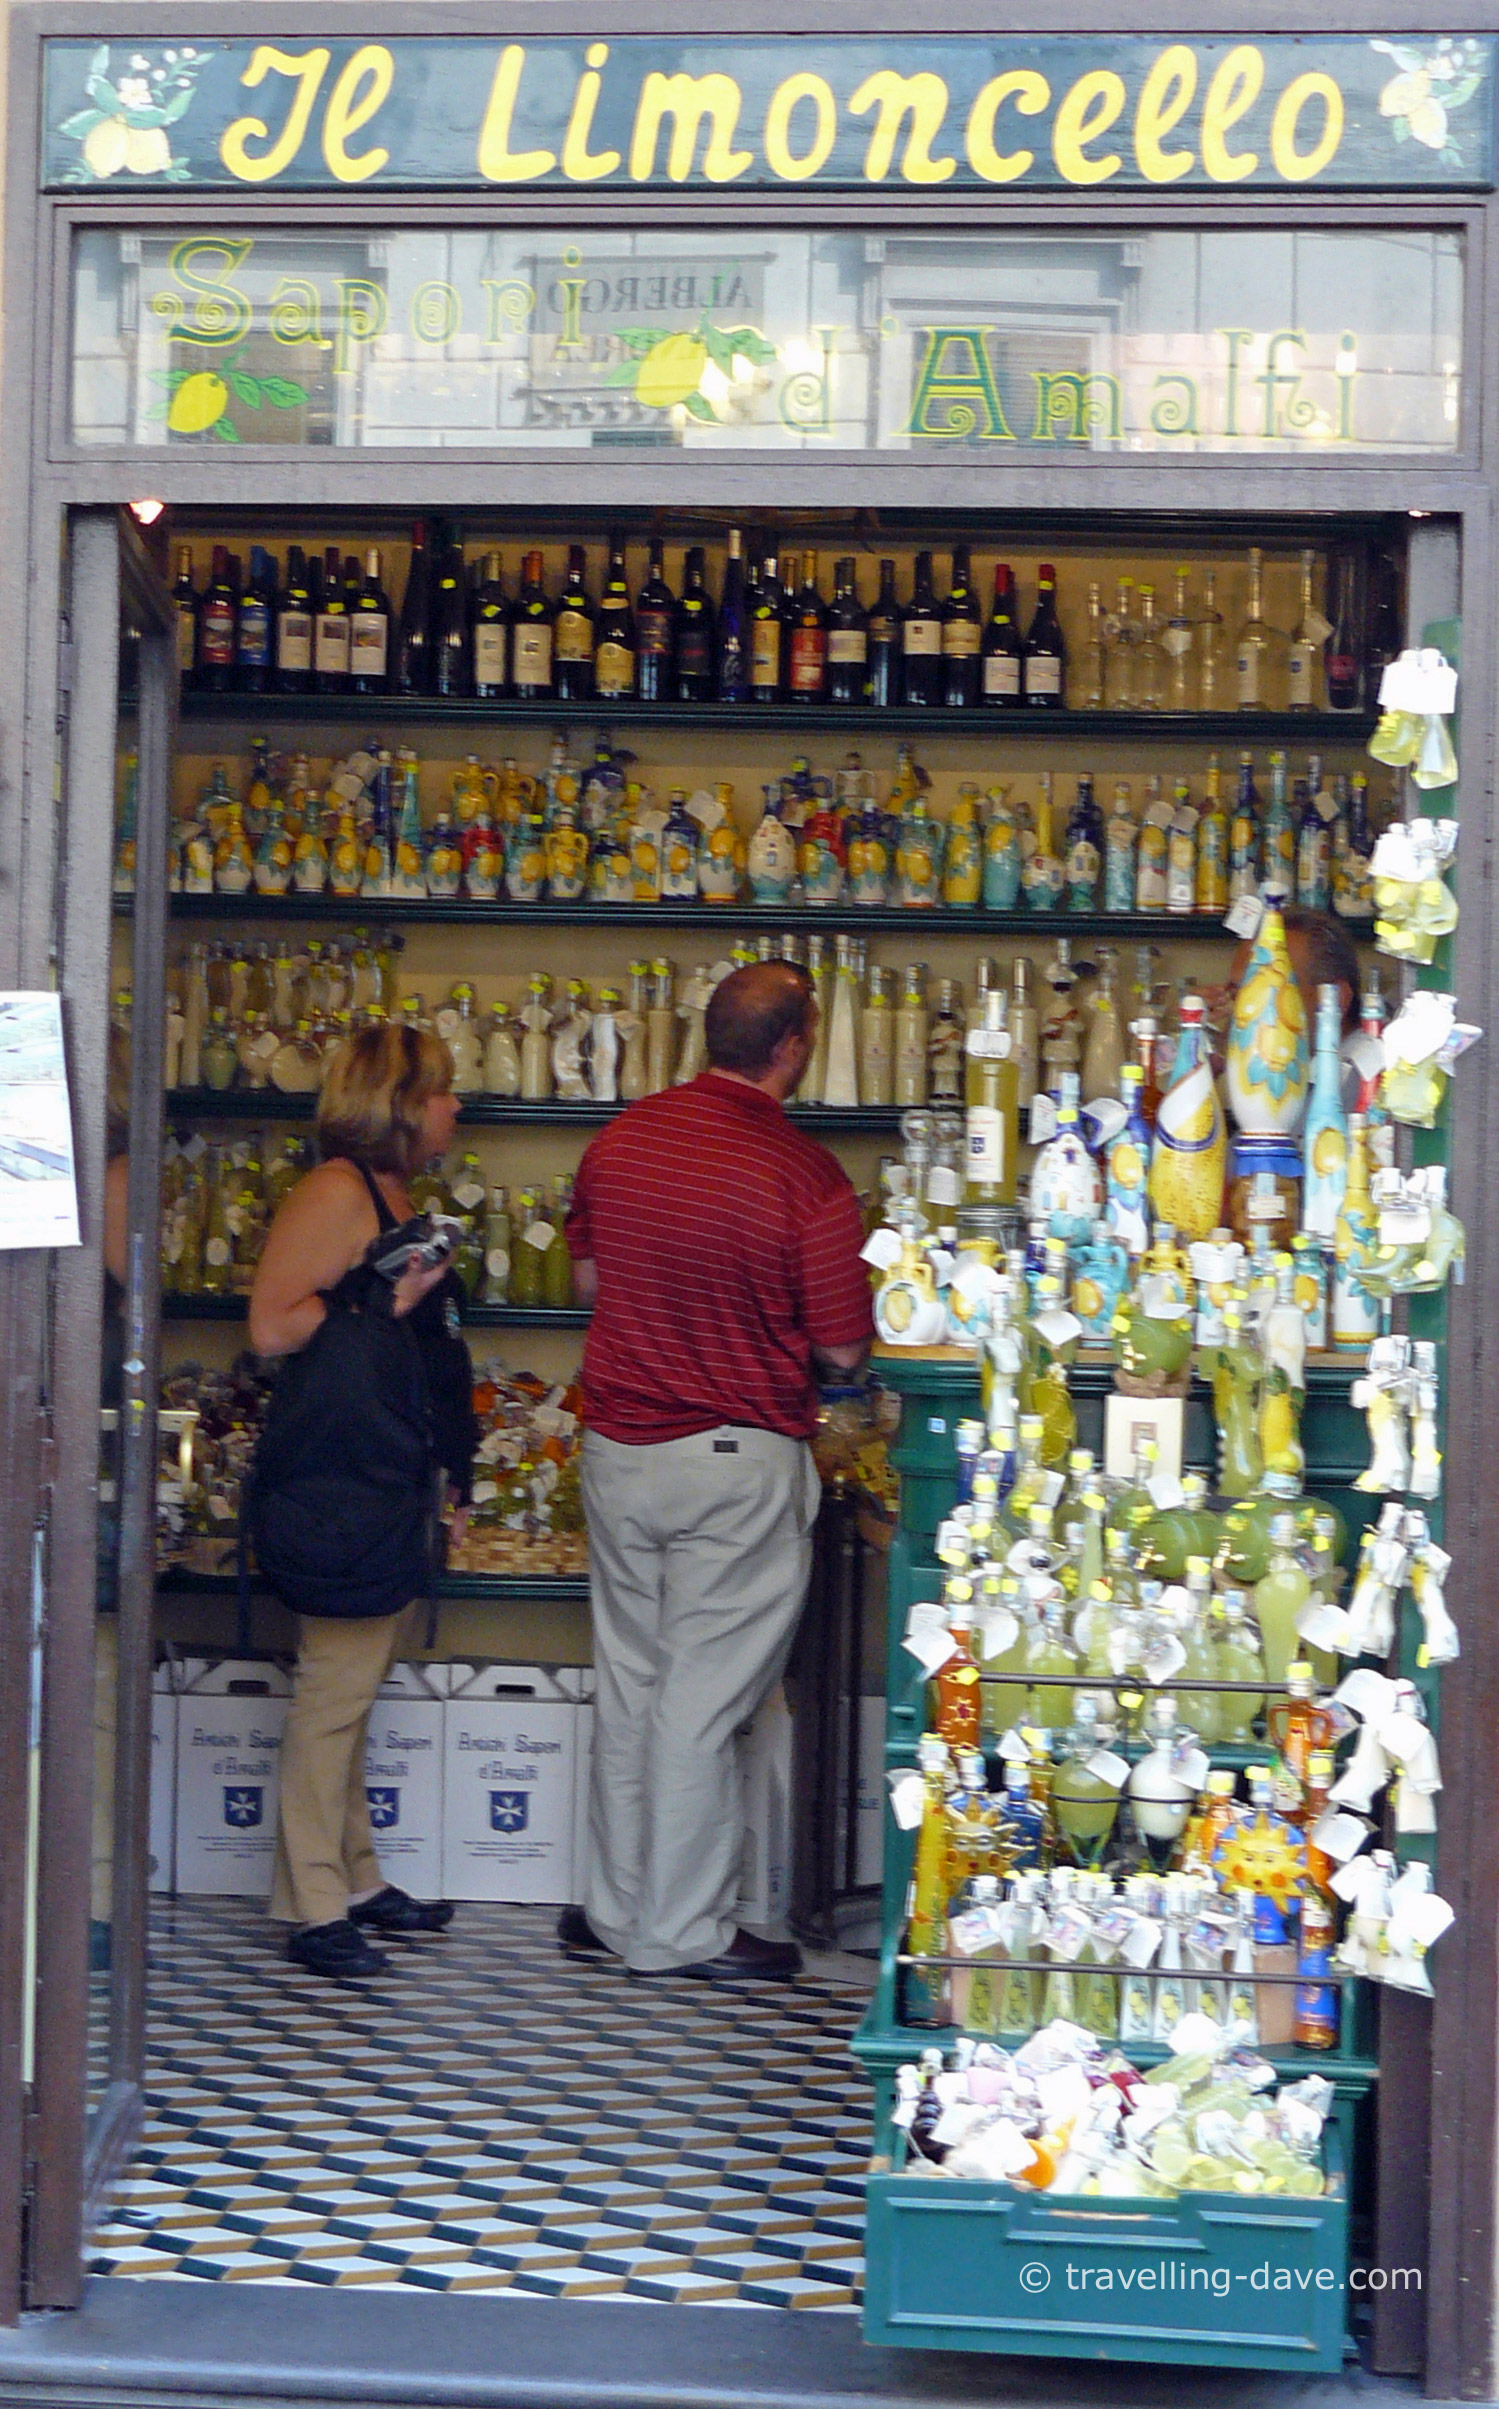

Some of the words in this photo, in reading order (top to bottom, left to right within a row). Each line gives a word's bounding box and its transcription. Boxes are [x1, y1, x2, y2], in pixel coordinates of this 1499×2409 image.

[476, 42, 1346, 185] Limoncello
[151, 236, 587, 374] Sapori
[777, 324, 1361, 441] d'Amalfi
